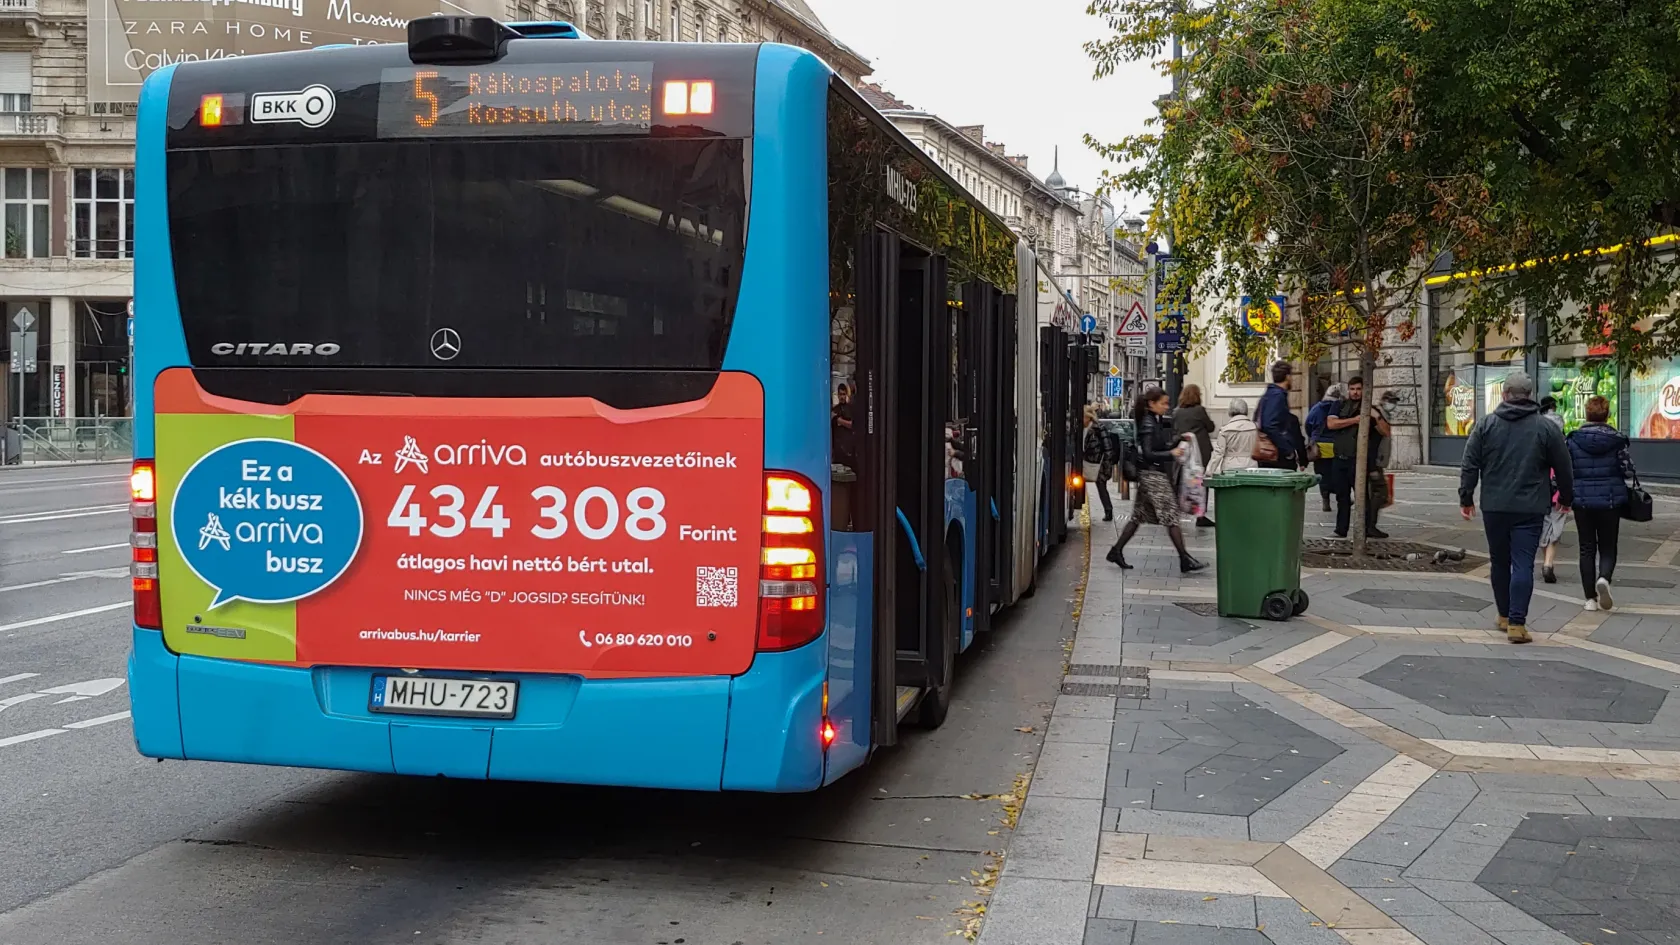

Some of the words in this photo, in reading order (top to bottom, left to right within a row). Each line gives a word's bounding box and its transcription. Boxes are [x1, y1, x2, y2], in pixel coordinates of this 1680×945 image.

[124, 21, 208, 35] ZARA
[226, 22, 313, 45] HOME
[262, 100, 297, 114] BKK
[415, 71, 438, 127] 5
[469, 100, 578, 123] Kossuth
[591, 100, 651, 122] utca
[886, 164, 917, 213] MHU-723
[211, 342, 341, 356] CITARO
[358, 449, 382, 465] Az
[433, 439, 527, 466] arriva
[539, 448, 737, 469] autóbuszvezetőinek
[242, 460, 271, 481] Ez
[277, 466, 293, 482] a
[219, 487, 260, 509] kék
[266, 488, 323, 511] busz
[387, 485, 511, 538] 434
[530, 486, 667, 541] 308
[235, 517, 323, 544] arriva
[679, 524, 737, 542] Forint
[266, 551, 323, 573] busz
[396, 554, 466, 574] átlagos
[470, 555, 508, 571] havi
[512, 556, 563, 572] nettó
[567, 556, 608, 573] bért
[611, 557, 654, 574] utal.
[404, 589, 447, 602] NINCS
[450, 587, 482, 602] MÉG
[509, 591, 568, 604] JOGSID?
[571, 590, 645, 606] SEGÍTÜNK!
[359, 628, 481, 643] arrivabus.hu/karrier
[595, 633, 614, 645] 06
[615, 633, 635, 646] 80
[637, 634, 664, 646] 620
[666, 634, 693, 647] 010
[374, 693, 382, 702] H
[390, 680, 508, 710] MHU-723
